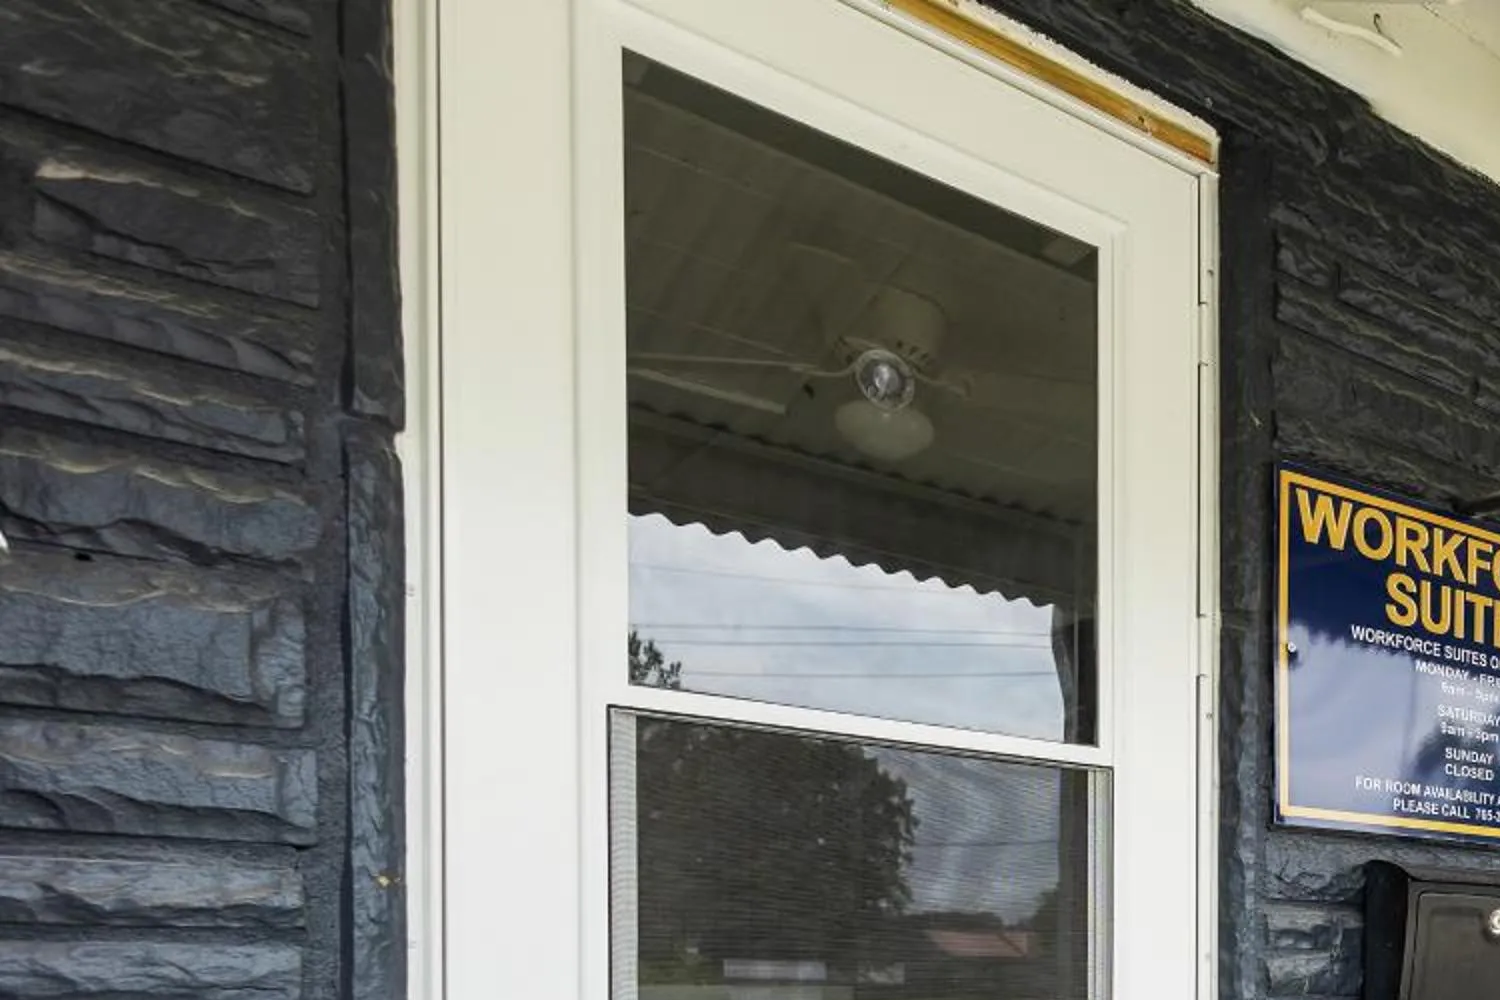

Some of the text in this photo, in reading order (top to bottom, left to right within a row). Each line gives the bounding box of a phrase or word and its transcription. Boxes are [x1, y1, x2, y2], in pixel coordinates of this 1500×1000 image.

[1351, 624, 1441, 657] WORKFORCE
[1445, 645, 1487, 667] SUITES
[1415, 659, 1469, 682] MONDAY
[1437, 704, 1500, 727] SATURDAY
[1445, 747, 1494, 765] SUNDAY
[1445, 763, 1494, 781] CLOSED
[1355, 776, 1381, 793] FOR
[1385, 777, 1421, 796] ROOM
[1423, 784, 1494, 806] AVAILABILITY
[1393, 799, 1439, 816] PLEASE
[1441, 804, 1470, 821] CALL
